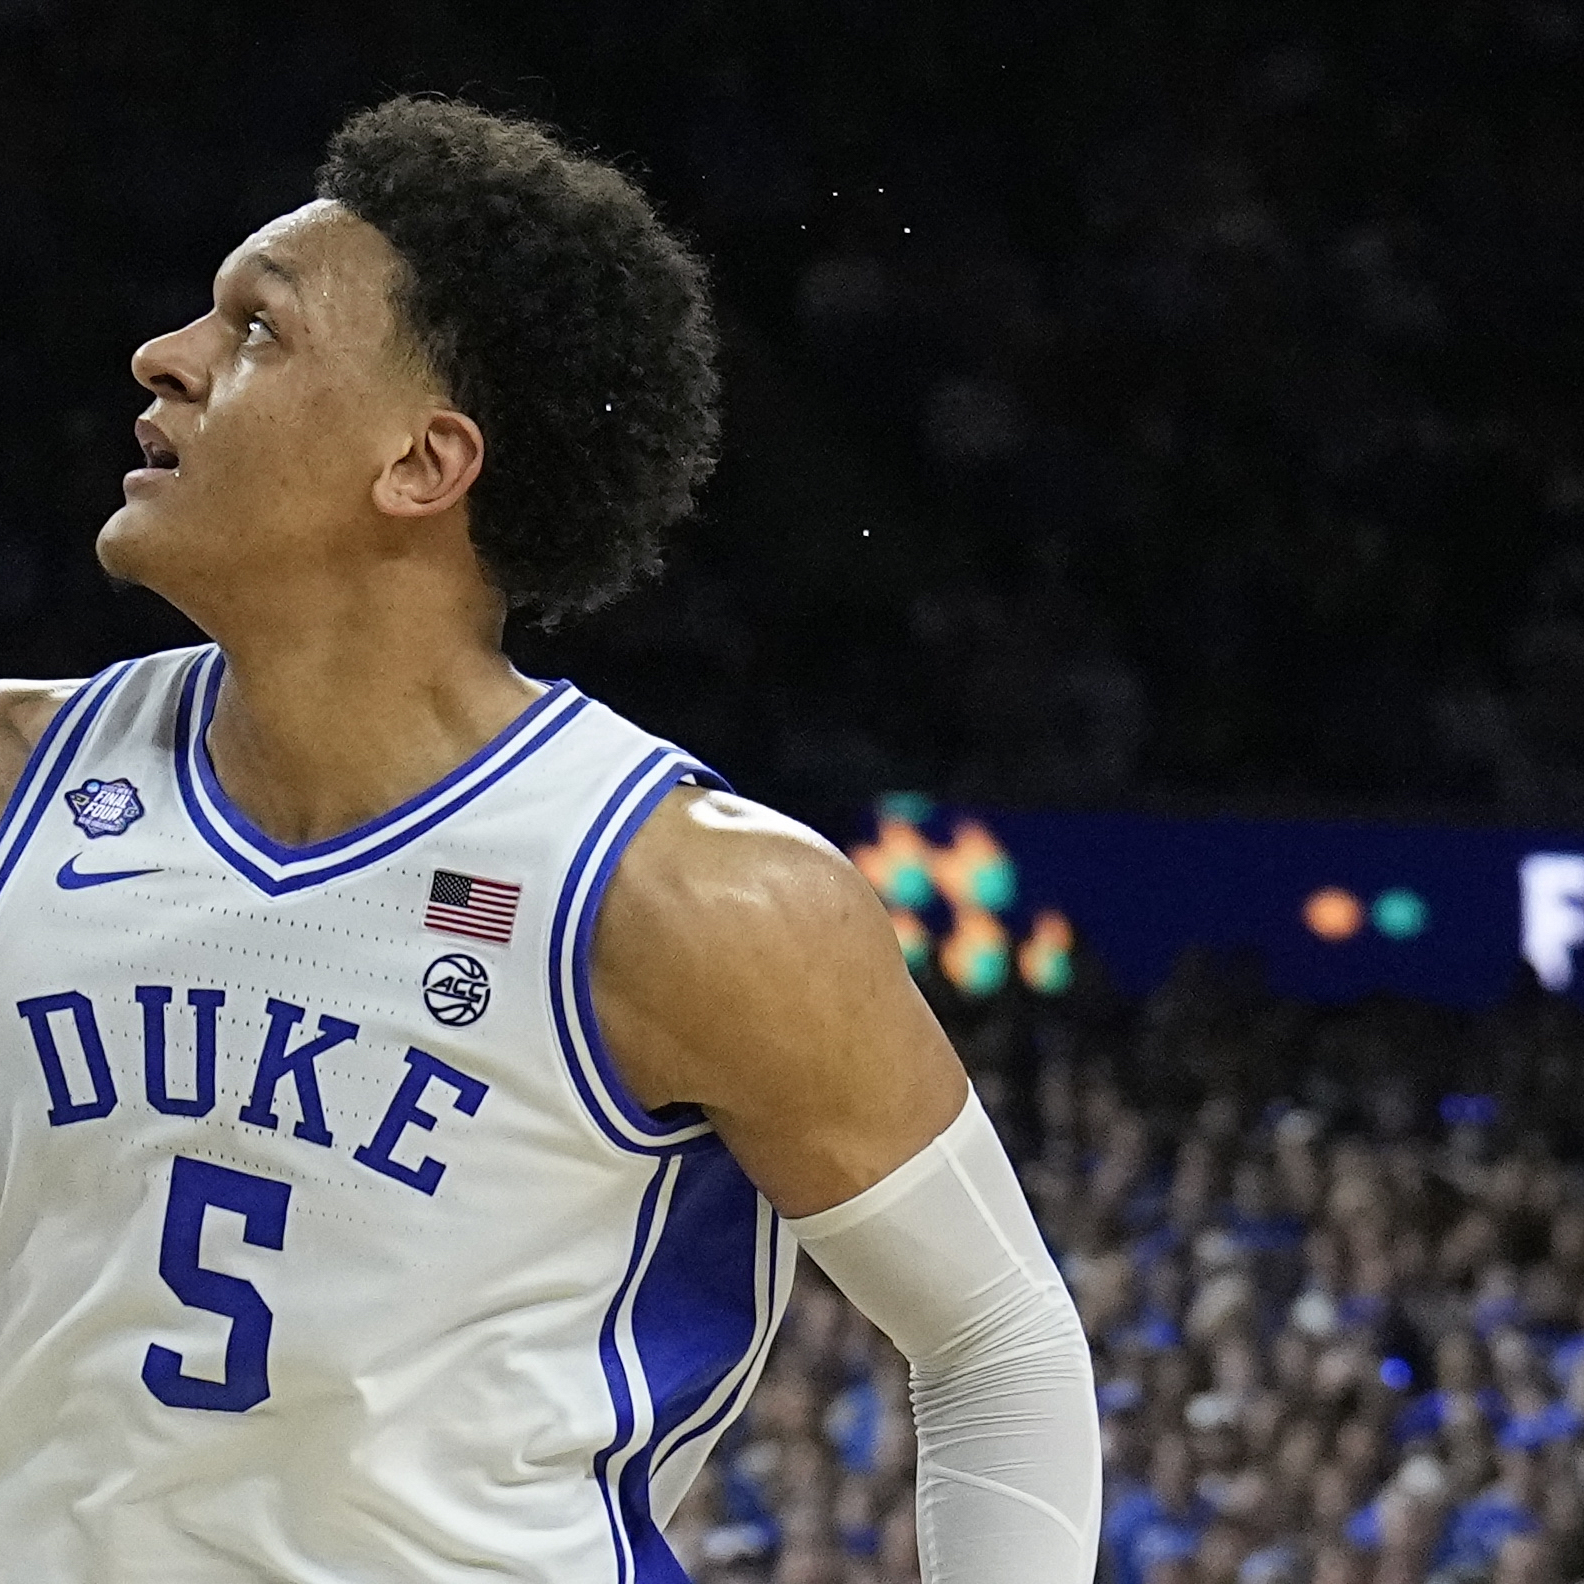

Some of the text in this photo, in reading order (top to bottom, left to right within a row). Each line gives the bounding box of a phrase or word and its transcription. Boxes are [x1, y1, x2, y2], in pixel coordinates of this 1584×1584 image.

[82, 801, 123, 821] FOUR
[94, 790, 130, 809] FINAL
[431, 975, 489, 1004] ACC
[16, 985, 490, 1196] DUKE
[141, 1155, 292, 1413] 5
